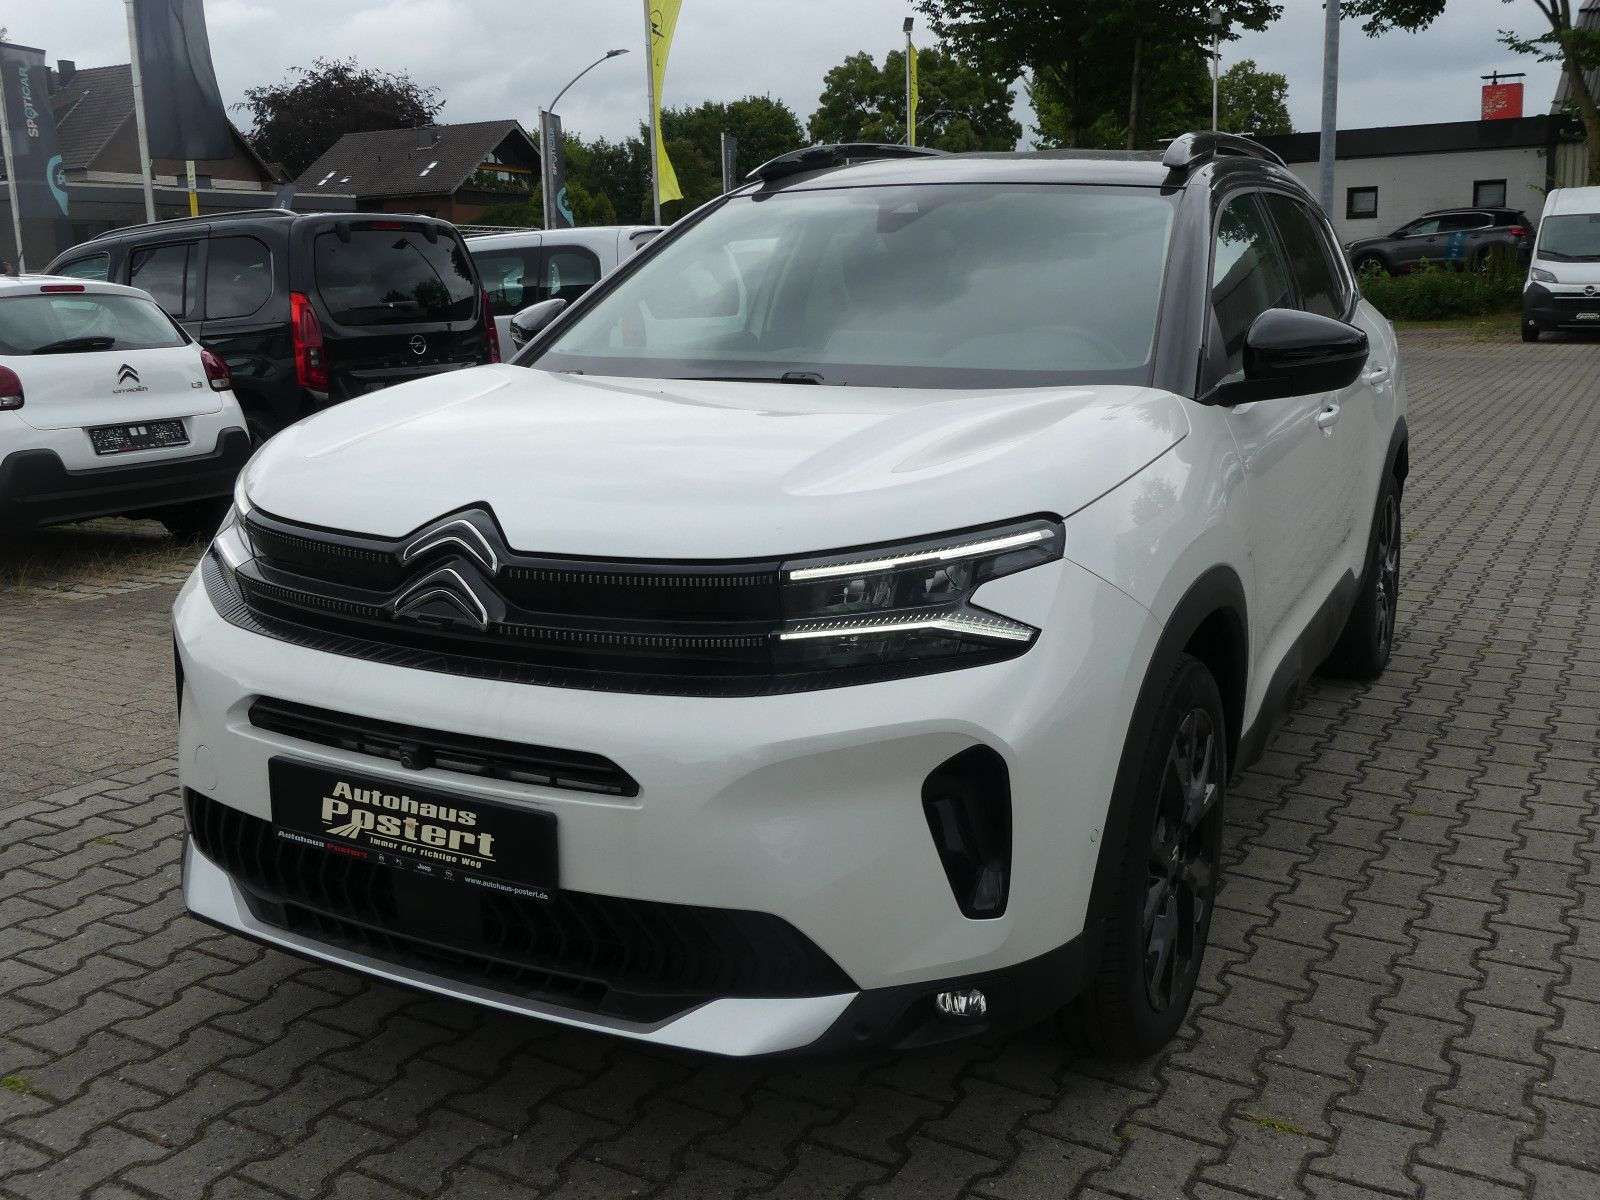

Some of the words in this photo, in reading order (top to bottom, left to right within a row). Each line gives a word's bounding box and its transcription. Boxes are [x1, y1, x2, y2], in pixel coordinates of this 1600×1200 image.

[18, 64, 39, 137] SPOTICAR
[191, 381, 203, 389] C3
[332, 781, 477, 826] Autohaus
[278, 830, 325, 848] Autohaus
[321, 797, 495, 857] Postert
[401, 844, 417, 855] der
[420, 849, 458, 863] richtige
[461, 857, 482, 869] Weg
[464, 876, 549, 900] www.autohaus-postert.de
